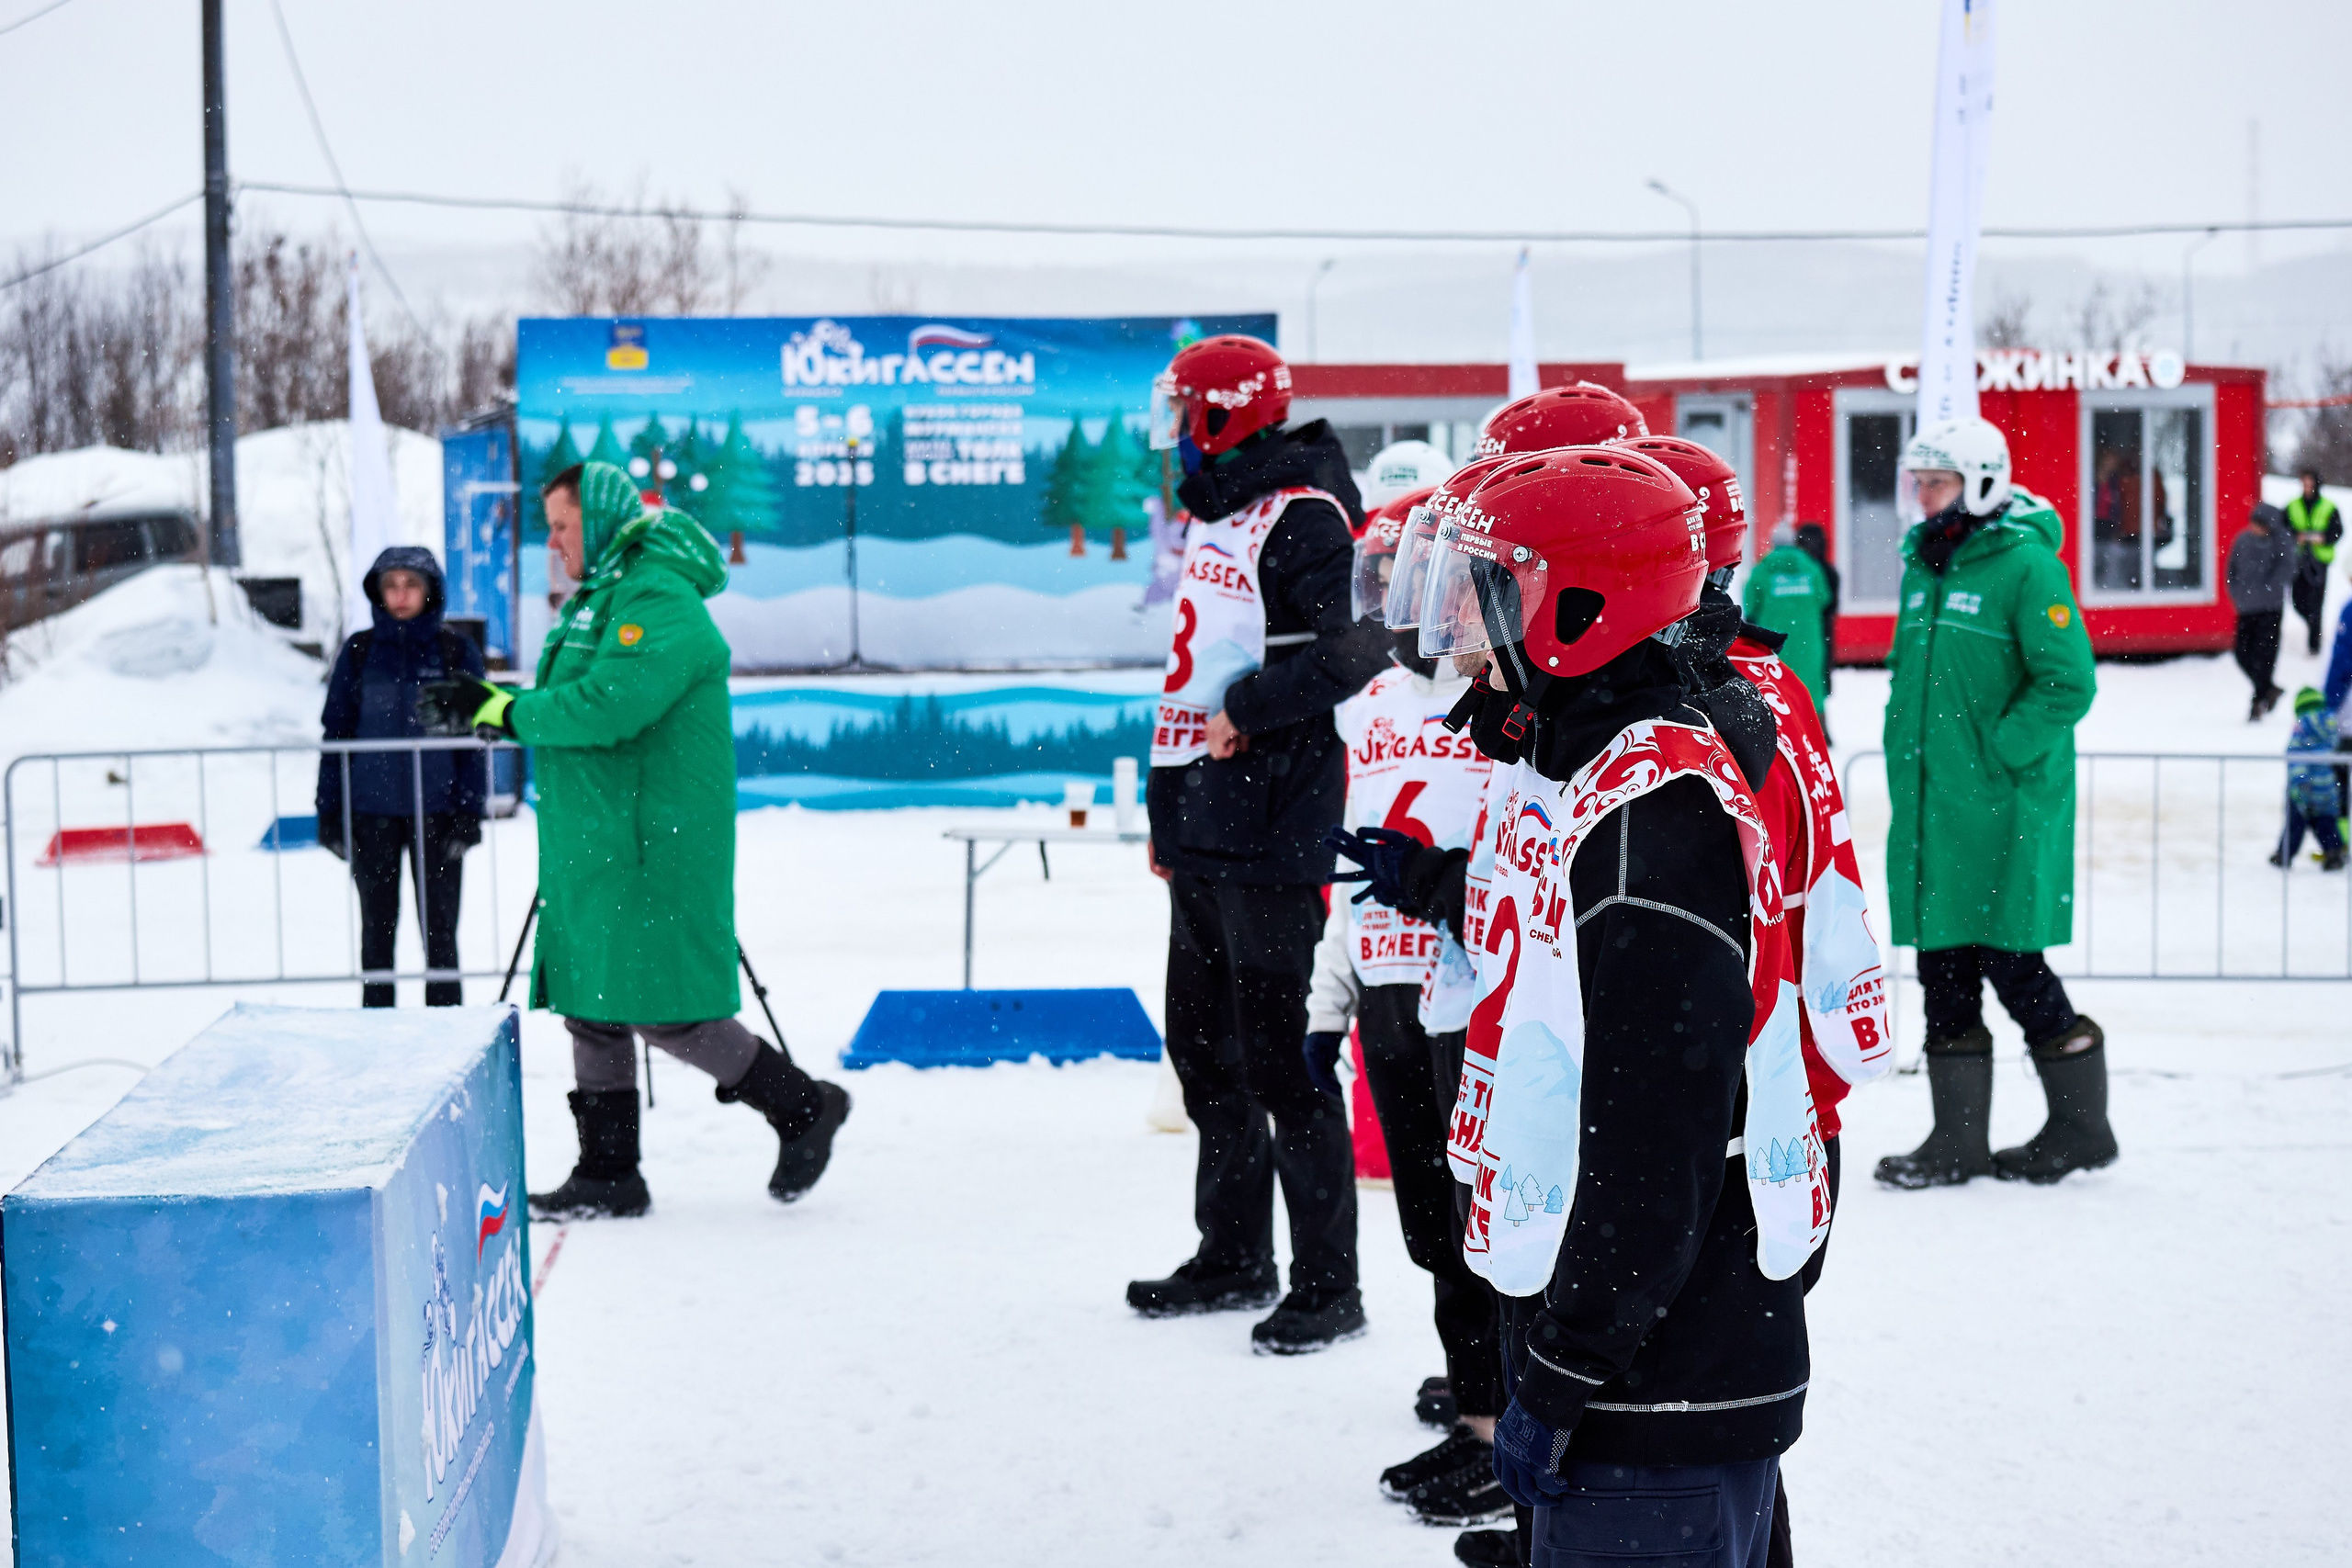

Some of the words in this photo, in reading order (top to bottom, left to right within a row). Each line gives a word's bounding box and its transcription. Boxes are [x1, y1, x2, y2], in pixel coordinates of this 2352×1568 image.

[1885, 349, 2151, 394] СЖИНКА
[1461, 533, 1493, 548] ПЕРВЫЕ
[1463, 545, 1498, 561] РОССИИ
[1159, 705, 1208, 726] ОЛК
[1382, 781, 1436, 850] 6
[1361, 935, 1373, 961] В
[1465, 895, 1521, 1062] 2
[1847, 981, 1873, 1003] ДЛЯ
[1846, 999, 1871, 1015] КТО
[1850, 1016, 1881, 1052] В
